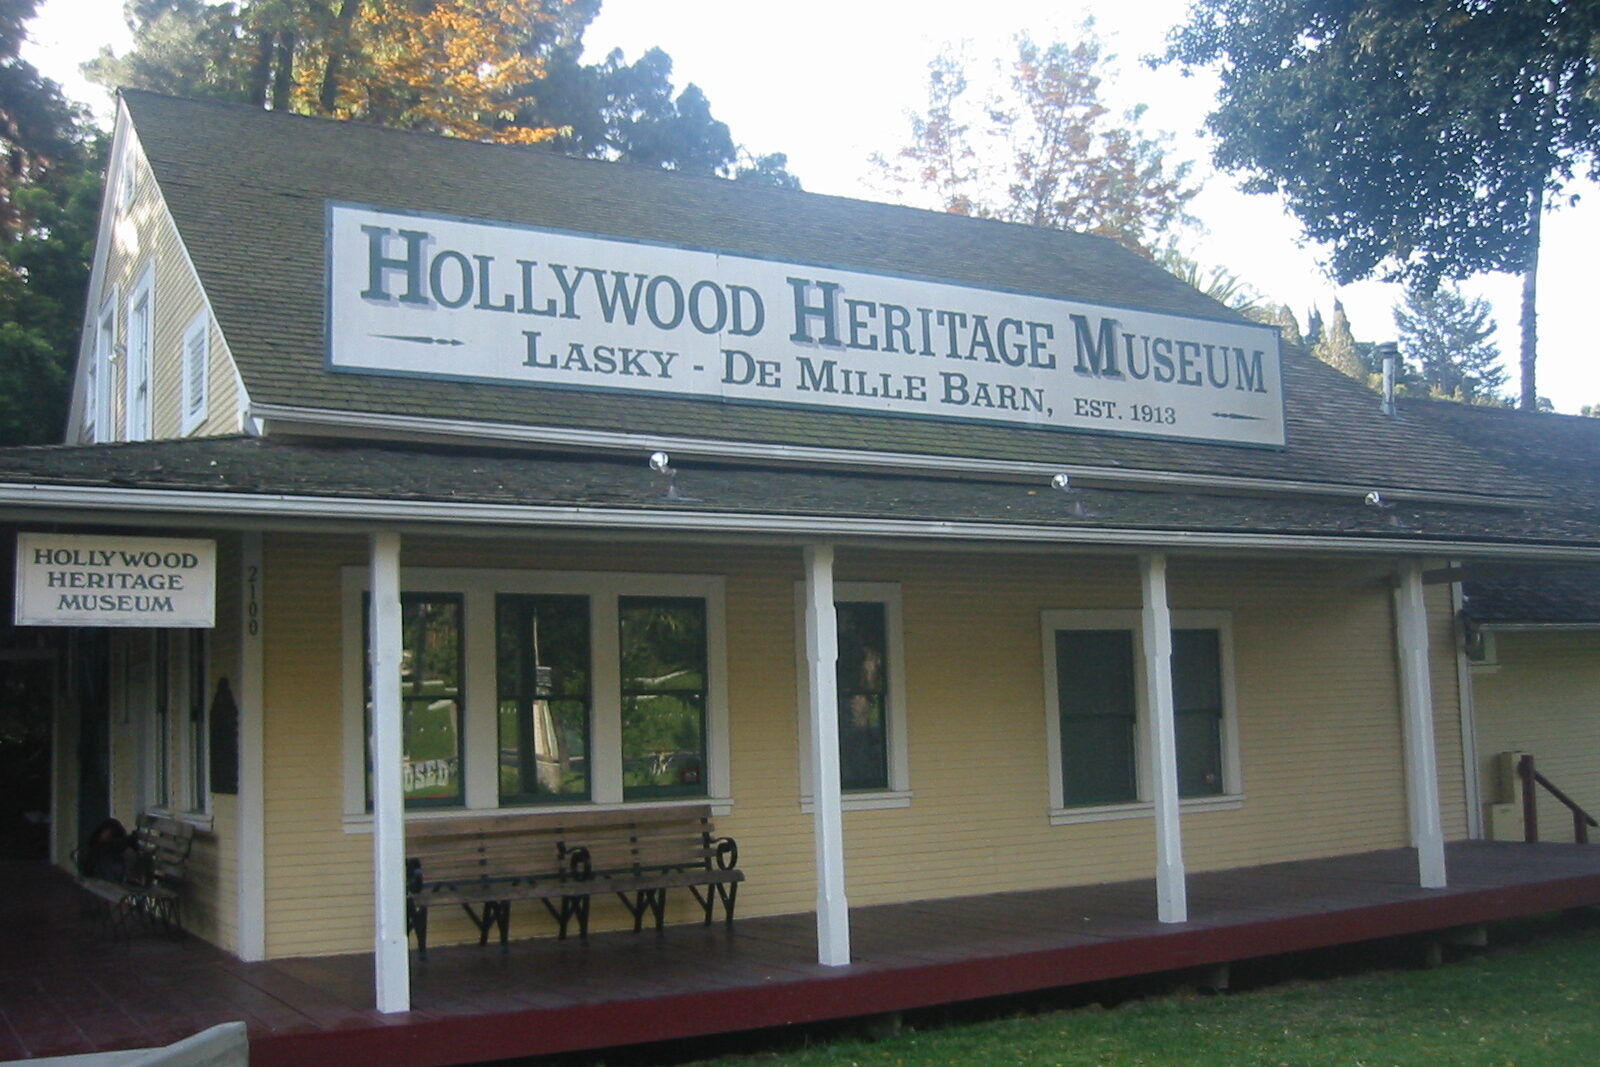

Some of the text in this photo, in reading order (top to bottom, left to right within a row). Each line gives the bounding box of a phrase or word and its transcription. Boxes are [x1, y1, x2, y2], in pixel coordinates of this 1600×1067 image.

[361, 224, 1268, 395] HOLLYWOOD HERITAGE MUSEUM
[522, 331, 679, 379] LASKY
[721, 349, 782, 388] DE
[796, 356, 928, 402] MILLE
[939, 371, 1054, 418] BARN,
[1074, 400, 1123, 420] EST.
[1130, 403, 1177, 426] 1913
[34, 548, 199, 570] HOLLYWOOD
[47, 571, 184, 591] HERITAGE
[57, 594, 174, 613] MUSEUM
[248, 566, 258, 636] 2100
